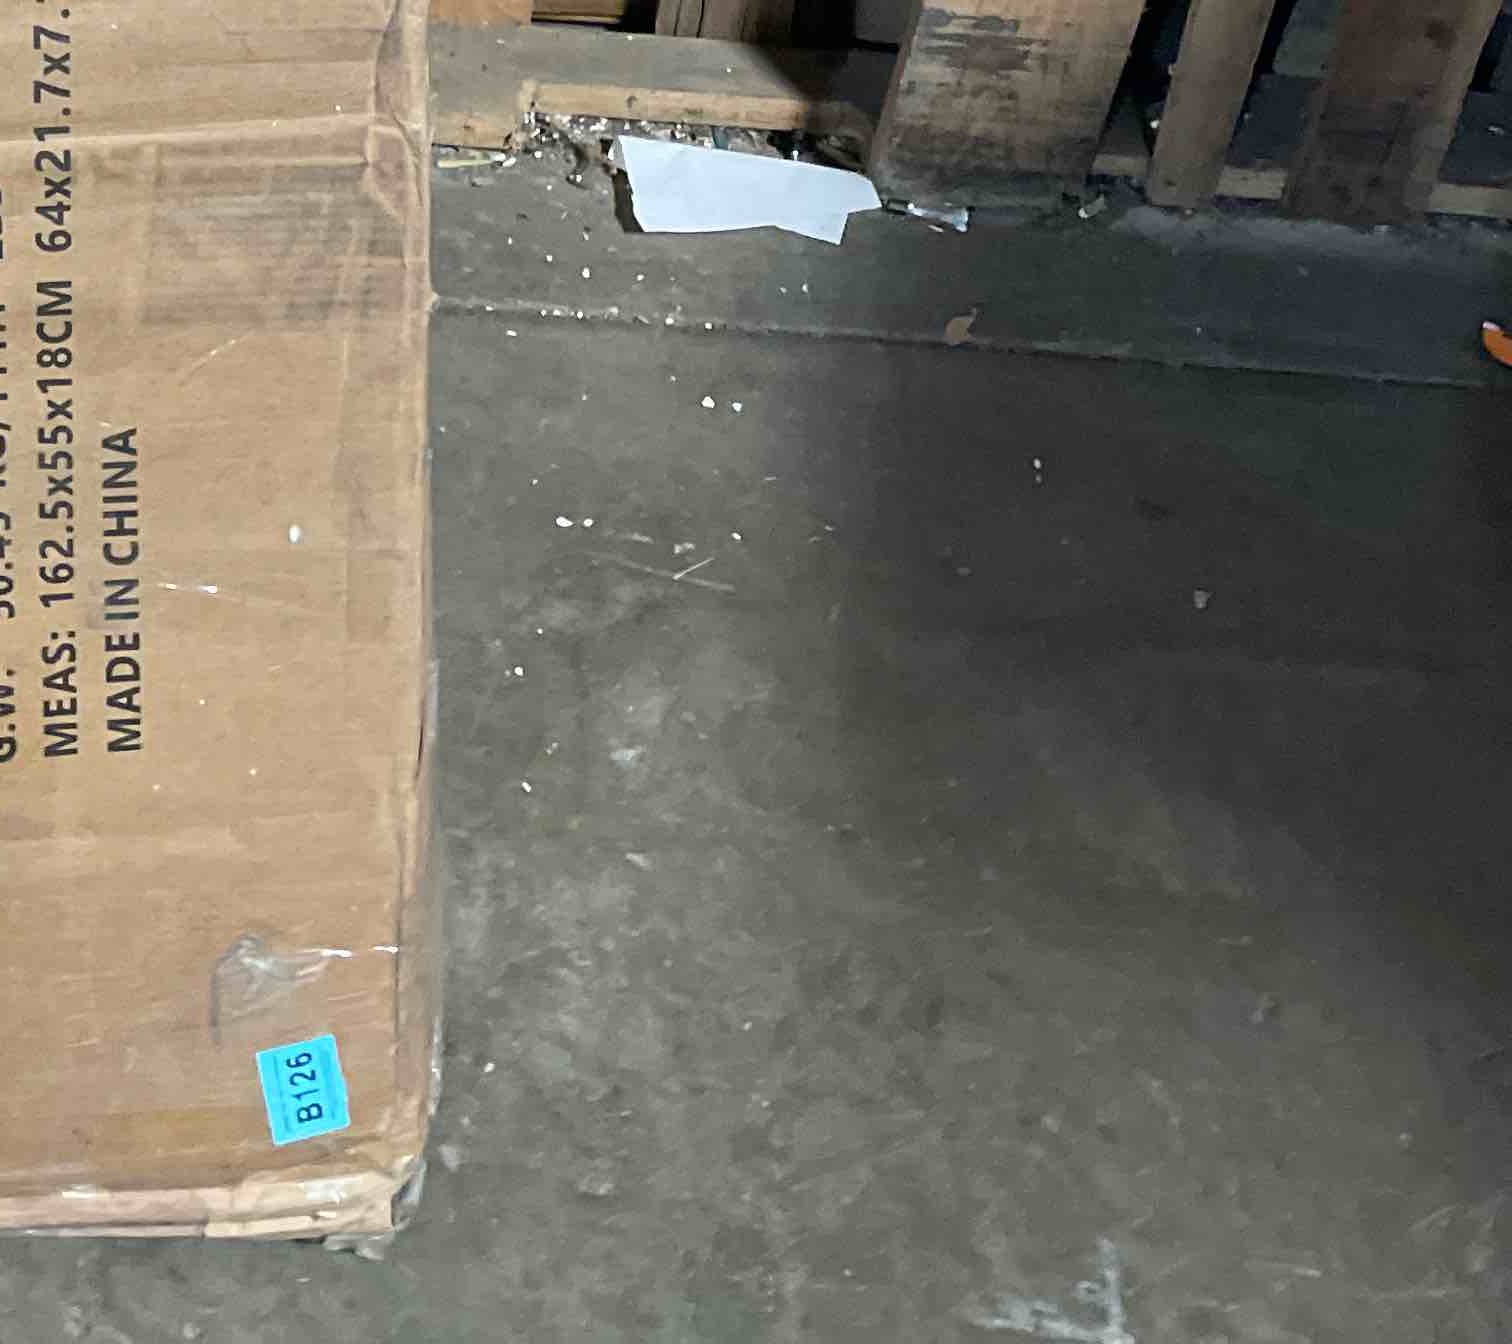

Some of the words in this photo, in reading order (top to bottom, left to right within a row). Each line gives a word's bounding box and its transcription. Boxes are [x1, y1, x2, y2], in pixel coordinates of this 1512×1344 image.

[36, 280, 76, 607] 162.5x55x18CM
[102, 428, 140, 566] CHINA
[104, 579, 141, 620] IN
[43, 629, 79, 758] MEAS:
[105, 631, 143, 752] MADE
[286, 1051, 324, 1124] B126
